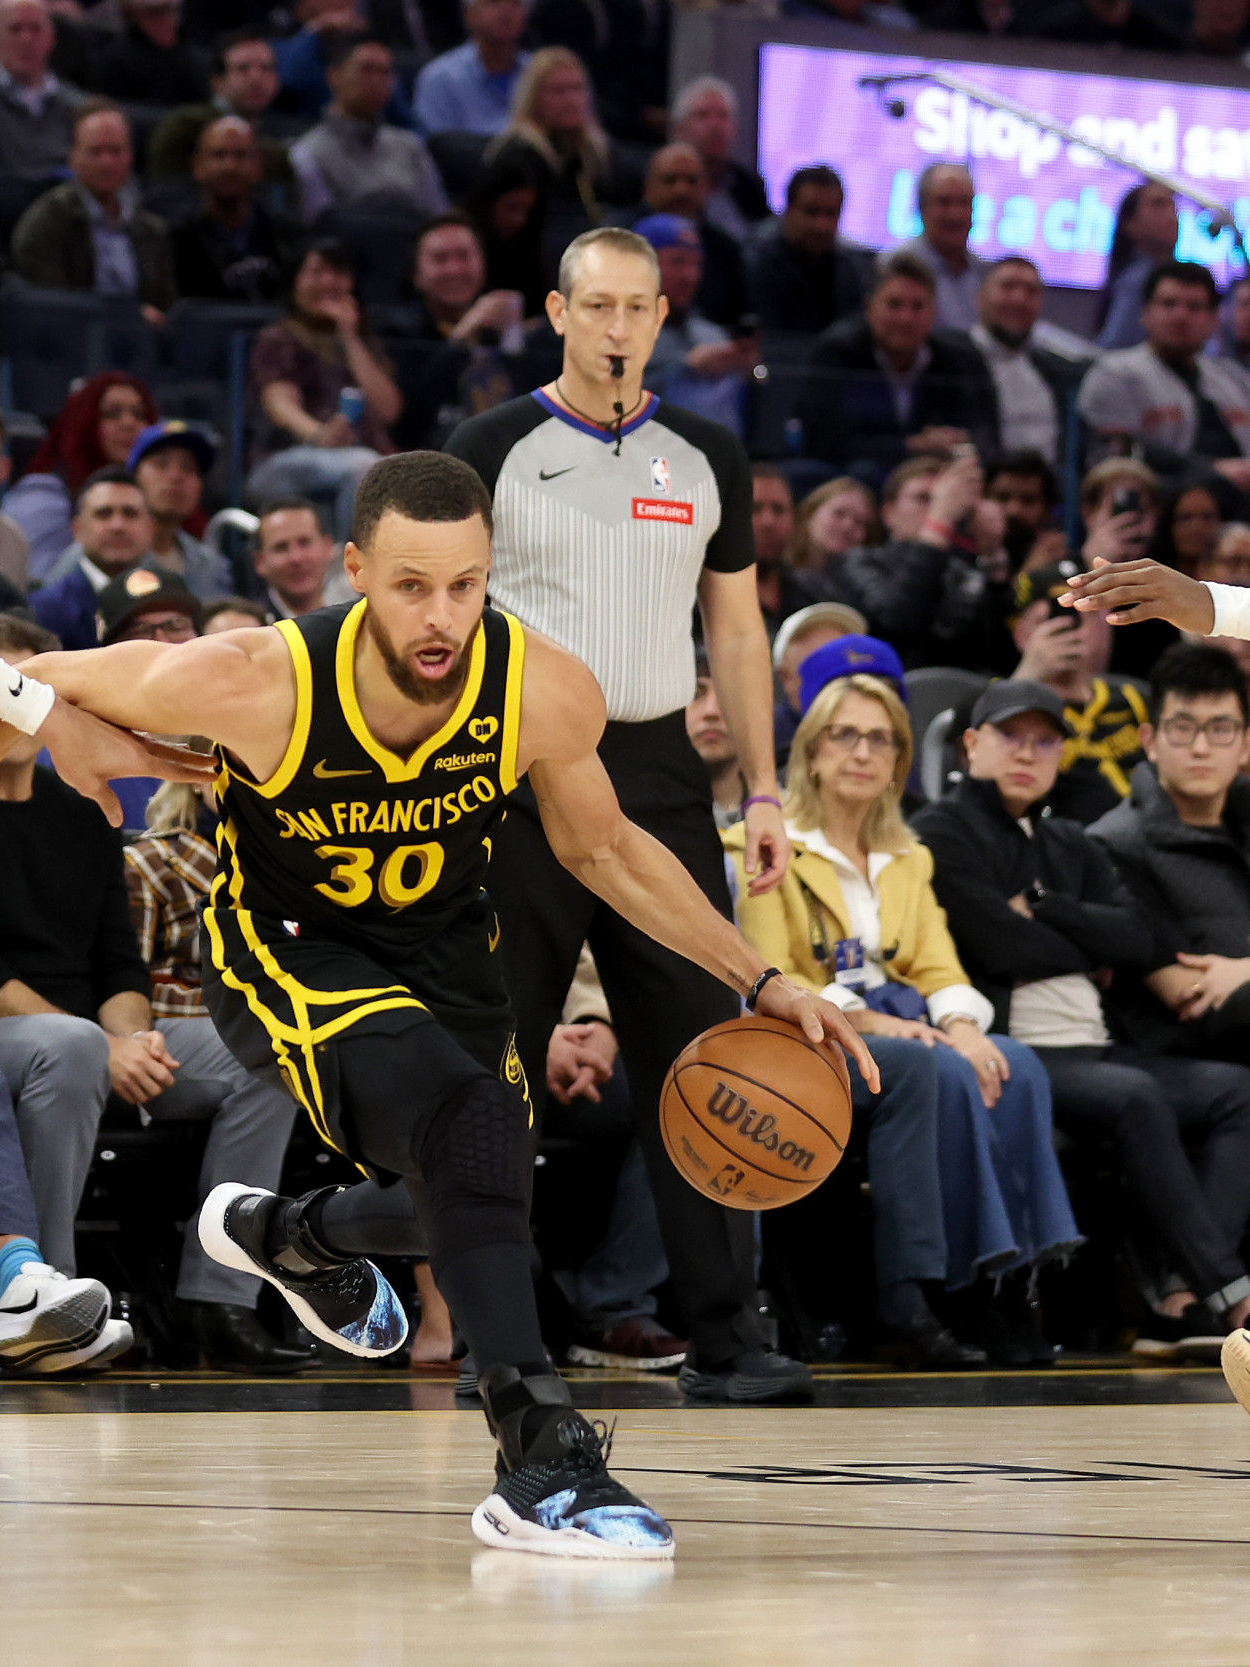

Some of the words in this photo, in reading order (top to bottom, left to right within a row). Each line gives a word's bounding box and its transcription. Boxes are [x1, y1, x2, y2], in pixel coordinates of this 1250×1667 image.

[914, 86, 1060, 179] Shop
[1066, 105, 1178, 171] and
[1182, 124, 1250, 181] sa
[635, 502, 690, 519] Emirates
[433, 751, 496, 771] Rakuten
[275, 807, 332, 841] SAN
[331, 775, 496, 834] FRANCISCO
[313, 841, 445, 908] 30
[707, 1081, 817, 1172] Wilson
